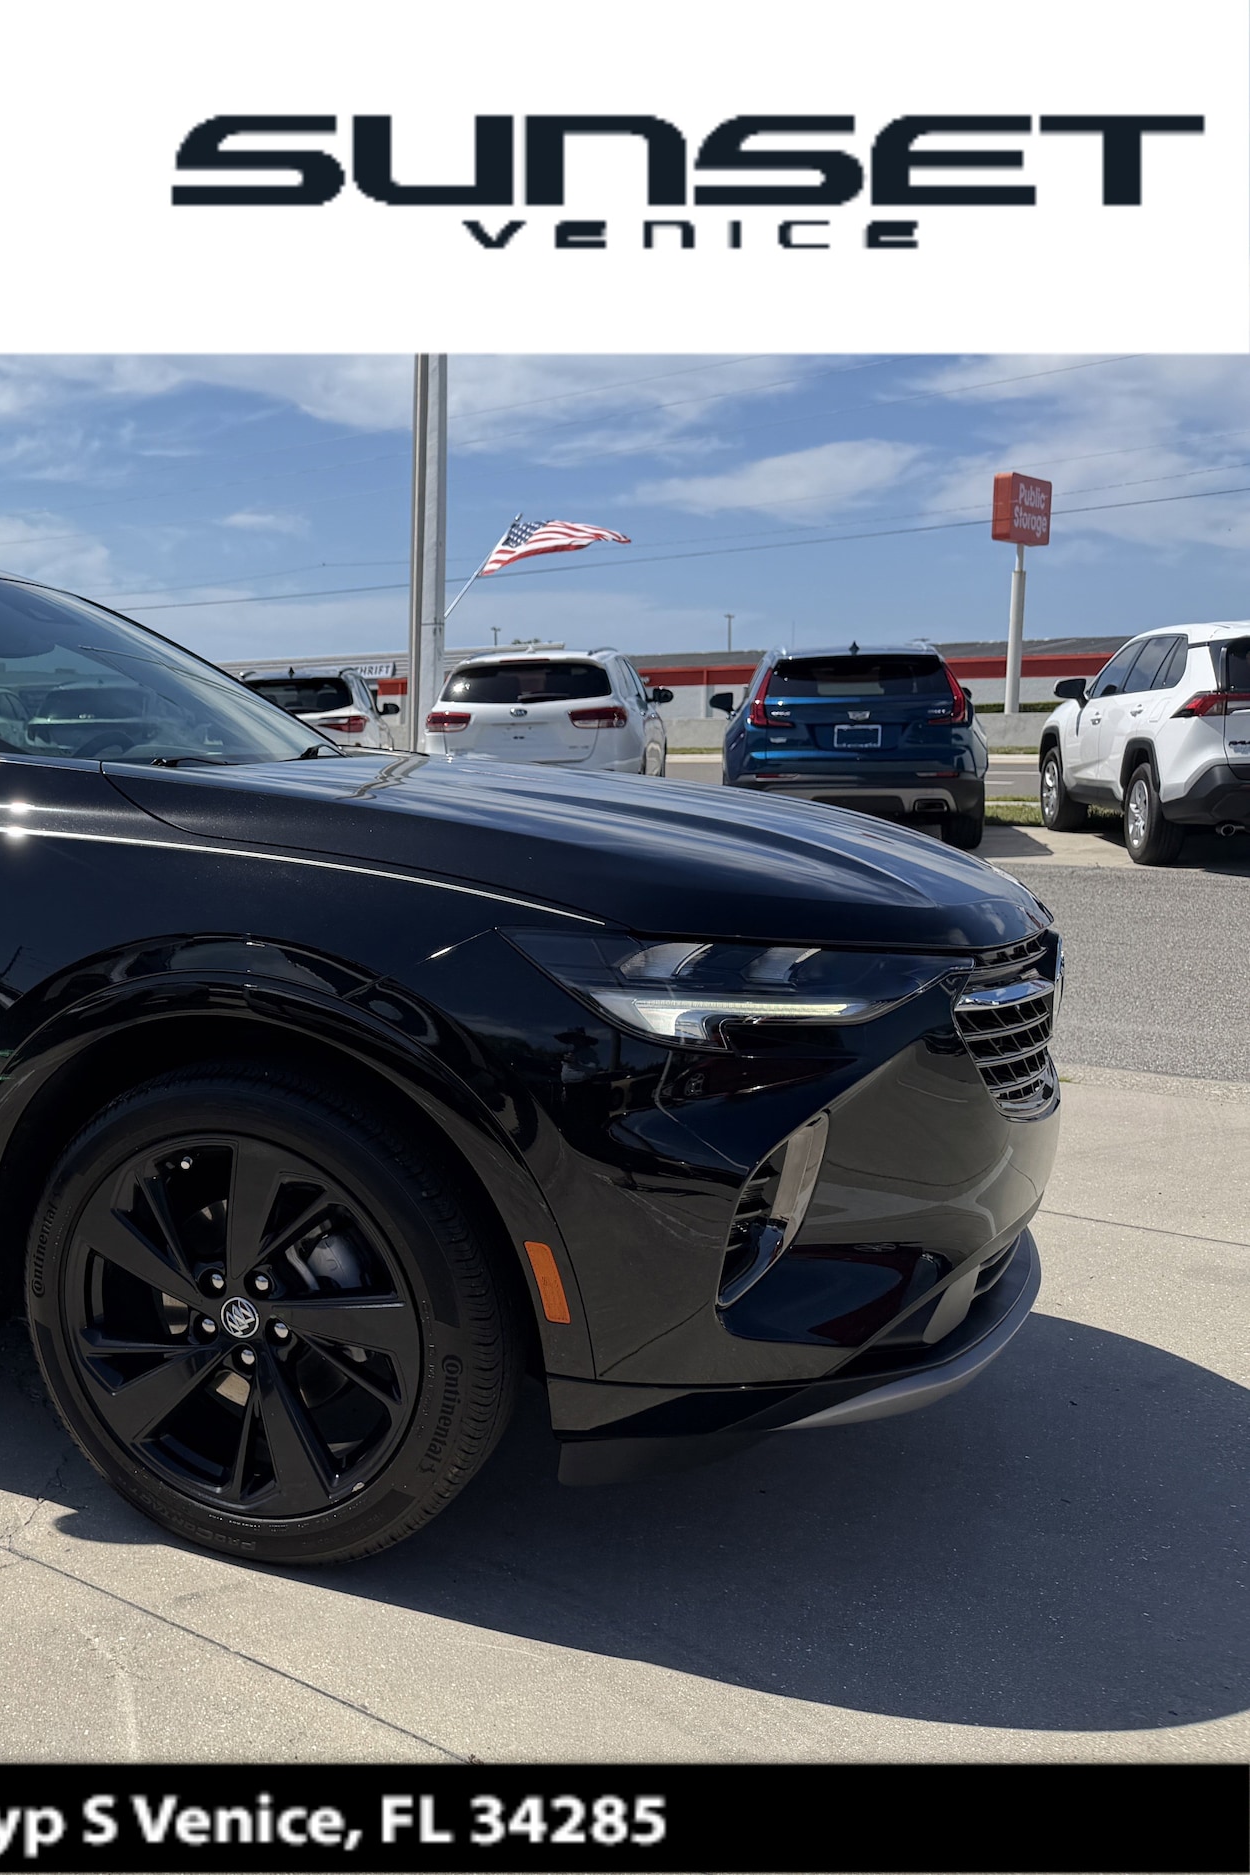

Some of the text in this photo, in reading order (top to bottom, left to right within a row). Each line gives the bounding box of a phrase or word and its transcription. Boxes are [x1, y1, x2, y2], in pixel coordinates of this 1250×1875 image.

[1013, 505, 1048, 538] Storage
[1018, 483, 1046, 510] Public
[31, 1201, 58, 1298] Continental
[424, 1354, 463, 1464] Continental
